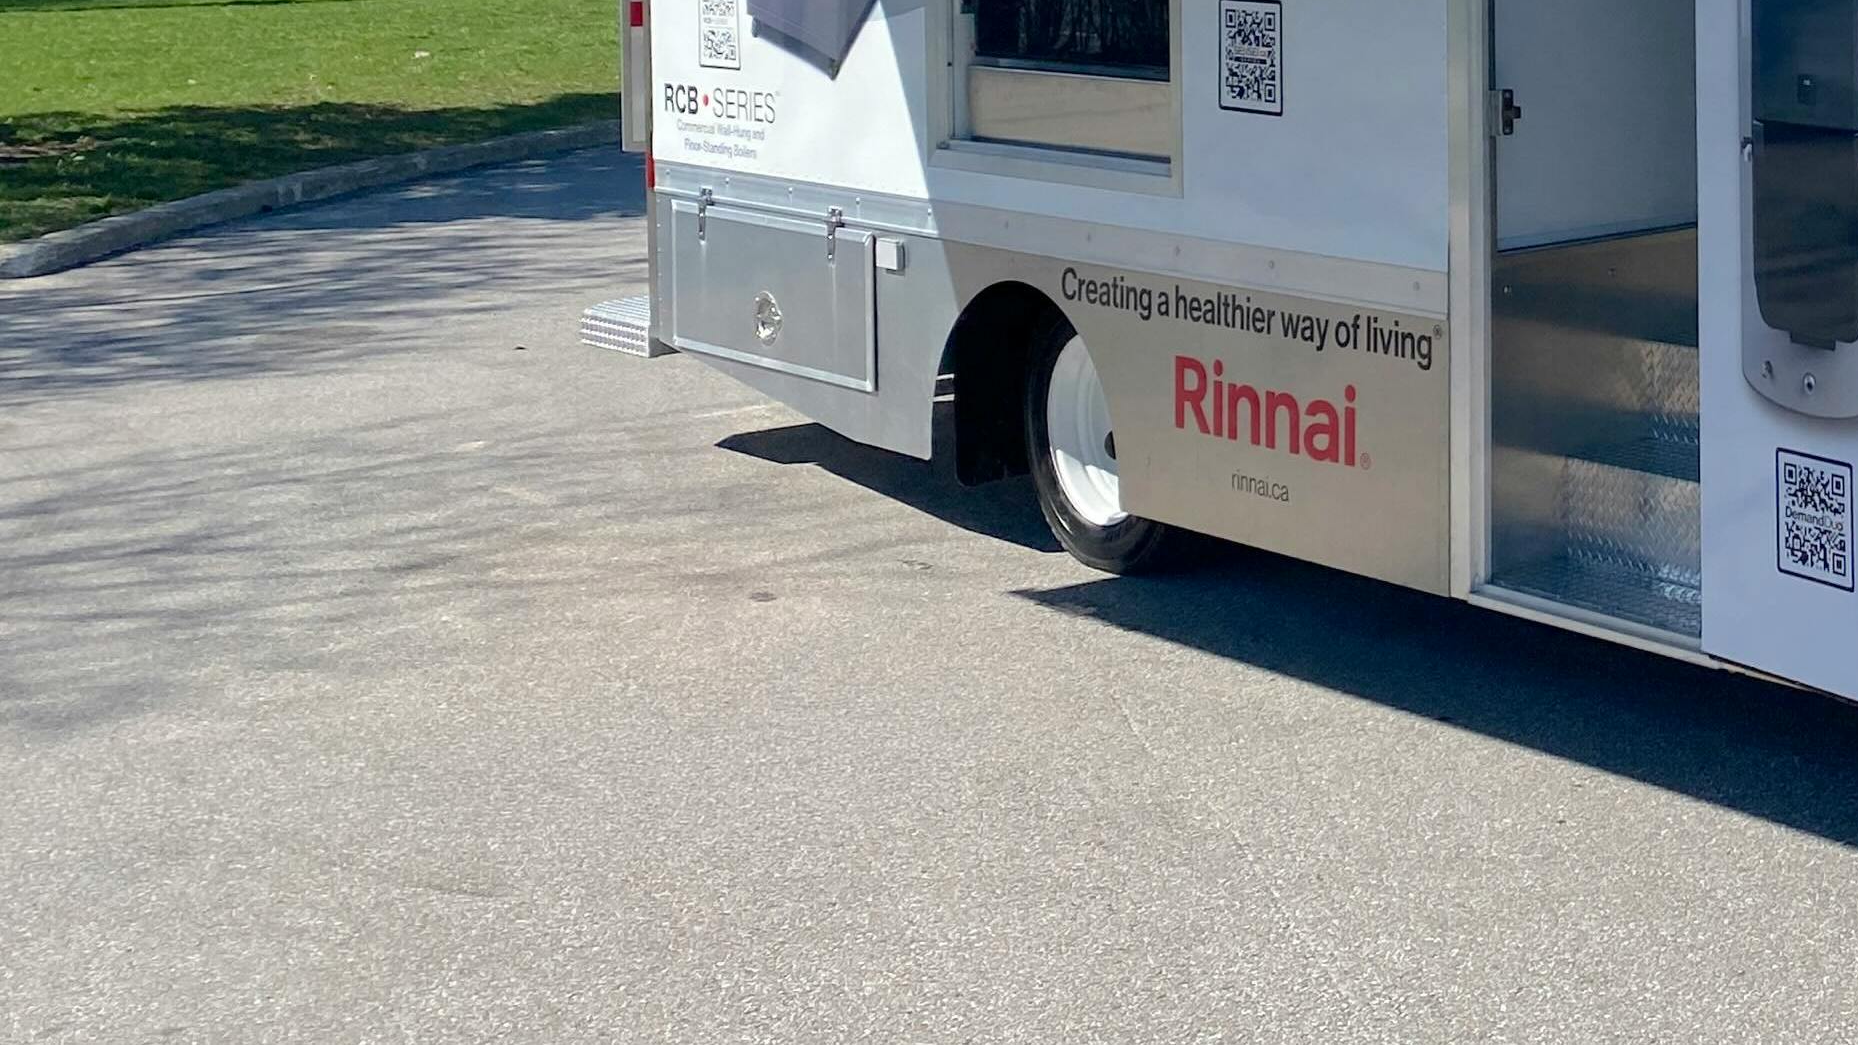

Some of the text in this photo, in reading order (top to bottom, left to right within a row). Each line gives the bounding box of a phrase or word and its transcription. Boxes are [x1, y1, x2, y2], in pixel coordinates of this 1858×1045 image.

[664, 83, 776, 124] RCB SERIES
[1062, 267, 1433, 371] Creating a healthier way of living
[1175, 355, 1357, 468] Rinnai
[1231, 469, 1290, 503] rinnai.ca
